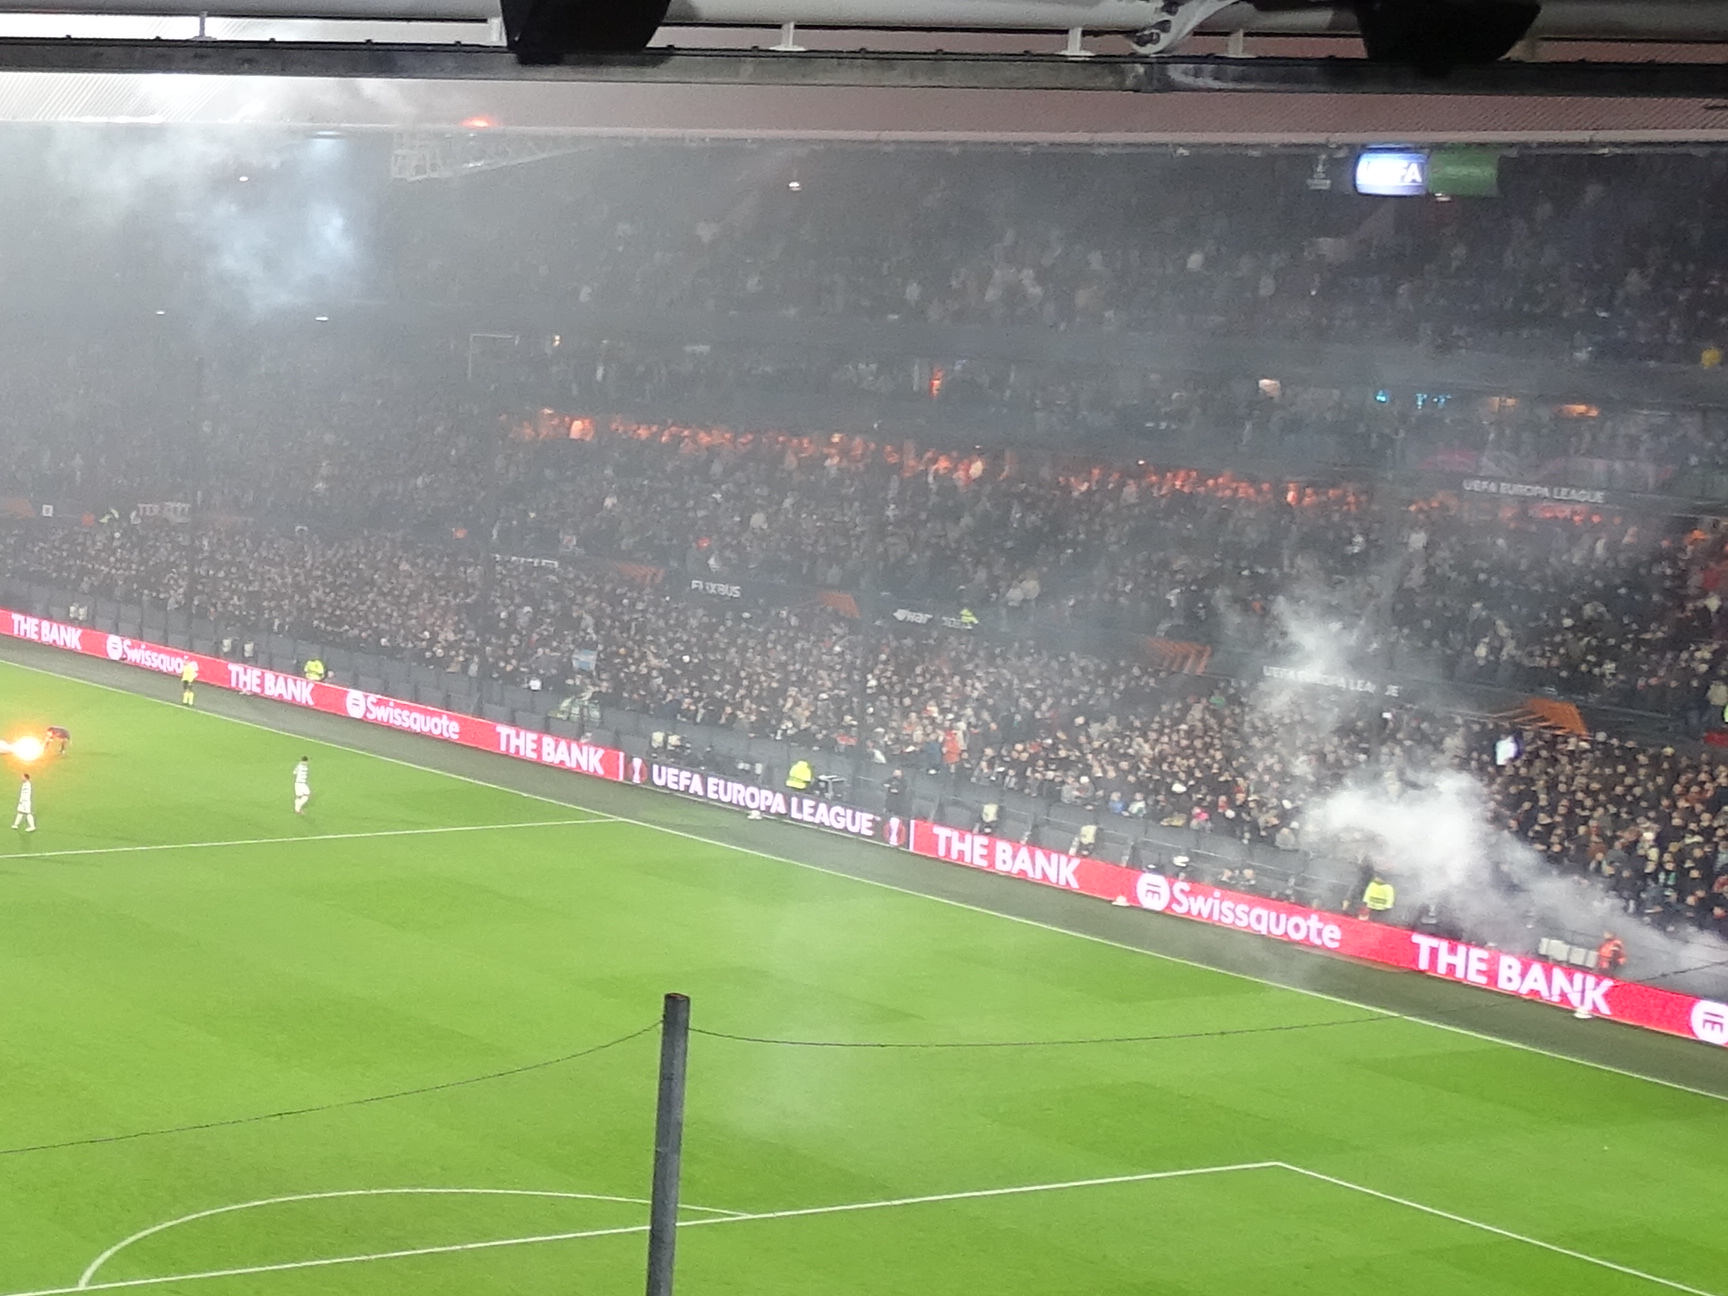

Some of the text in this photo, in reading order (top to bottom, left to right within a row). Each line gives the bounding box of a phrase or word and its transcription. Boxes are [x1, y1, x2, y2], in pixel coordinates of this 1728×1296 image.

[1463, 479, 1605, 504] UEFA EUROPA LEAGUE
[11, 612, 83, 651] THE BANK
[122, 635, 199, 675] Swissquoe
[228, 662, 315, 706] THE BANK
[365, 696, 460, 740] Swissquote
[495, 723, 605, 776] THE BANK
[651, 763, 874, 837] UEFA EUROPA LEAGUE
[933, 823, 1081, 889] THE BANK
[1170, 878, 1342, 950] Swissquote
[1410, 931, 1617, 1016] THE BANK
